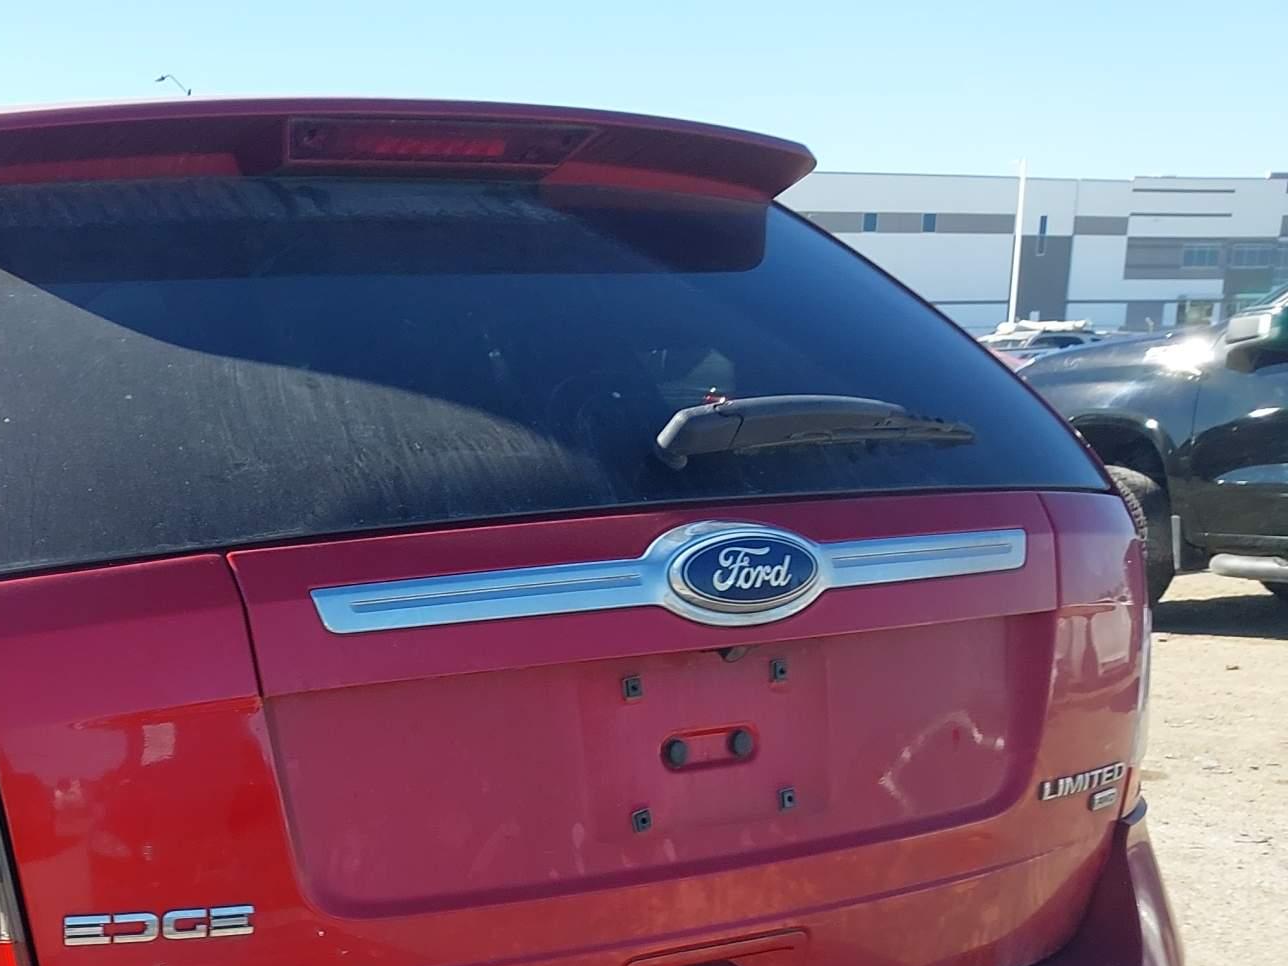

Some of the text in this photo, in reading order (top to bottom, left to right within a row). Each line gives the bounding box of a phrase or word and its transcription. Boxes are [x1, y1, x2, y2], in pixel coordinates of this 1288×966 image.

[713, 546, 793, 592] Ford
[1040, 761, 1127, 801] LIMITED
[63, 904, 256, 947] EDGE
